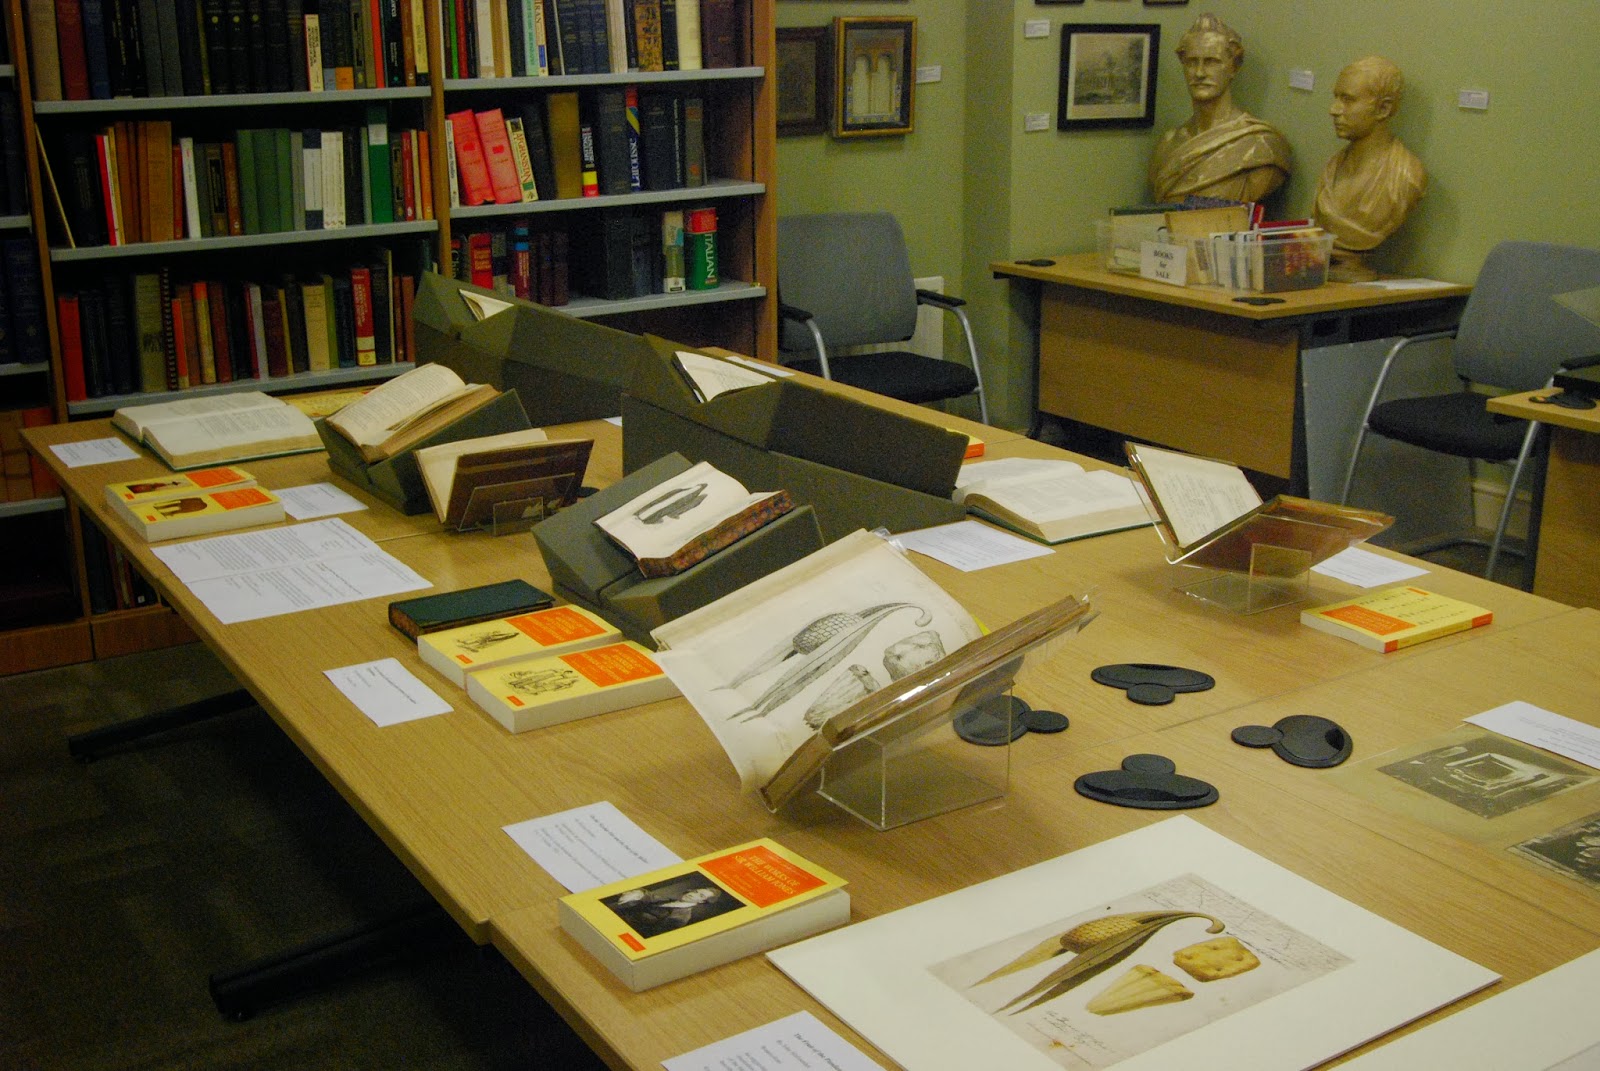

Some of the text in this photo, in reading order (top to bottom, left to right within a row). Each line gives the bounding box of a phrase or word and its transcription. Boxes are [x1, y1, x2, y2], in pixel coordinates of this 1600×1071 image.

[514, 133, 531, 183] AFGHANISTAN
[629, 137, 640, 187] Larousse
[704, 233, 716, 278] ITALIAN
[744, 861, 776, 882] WILLIAM
[771, 879, 795, 895] JONES
[763, 864, 790, 880] WORKS
